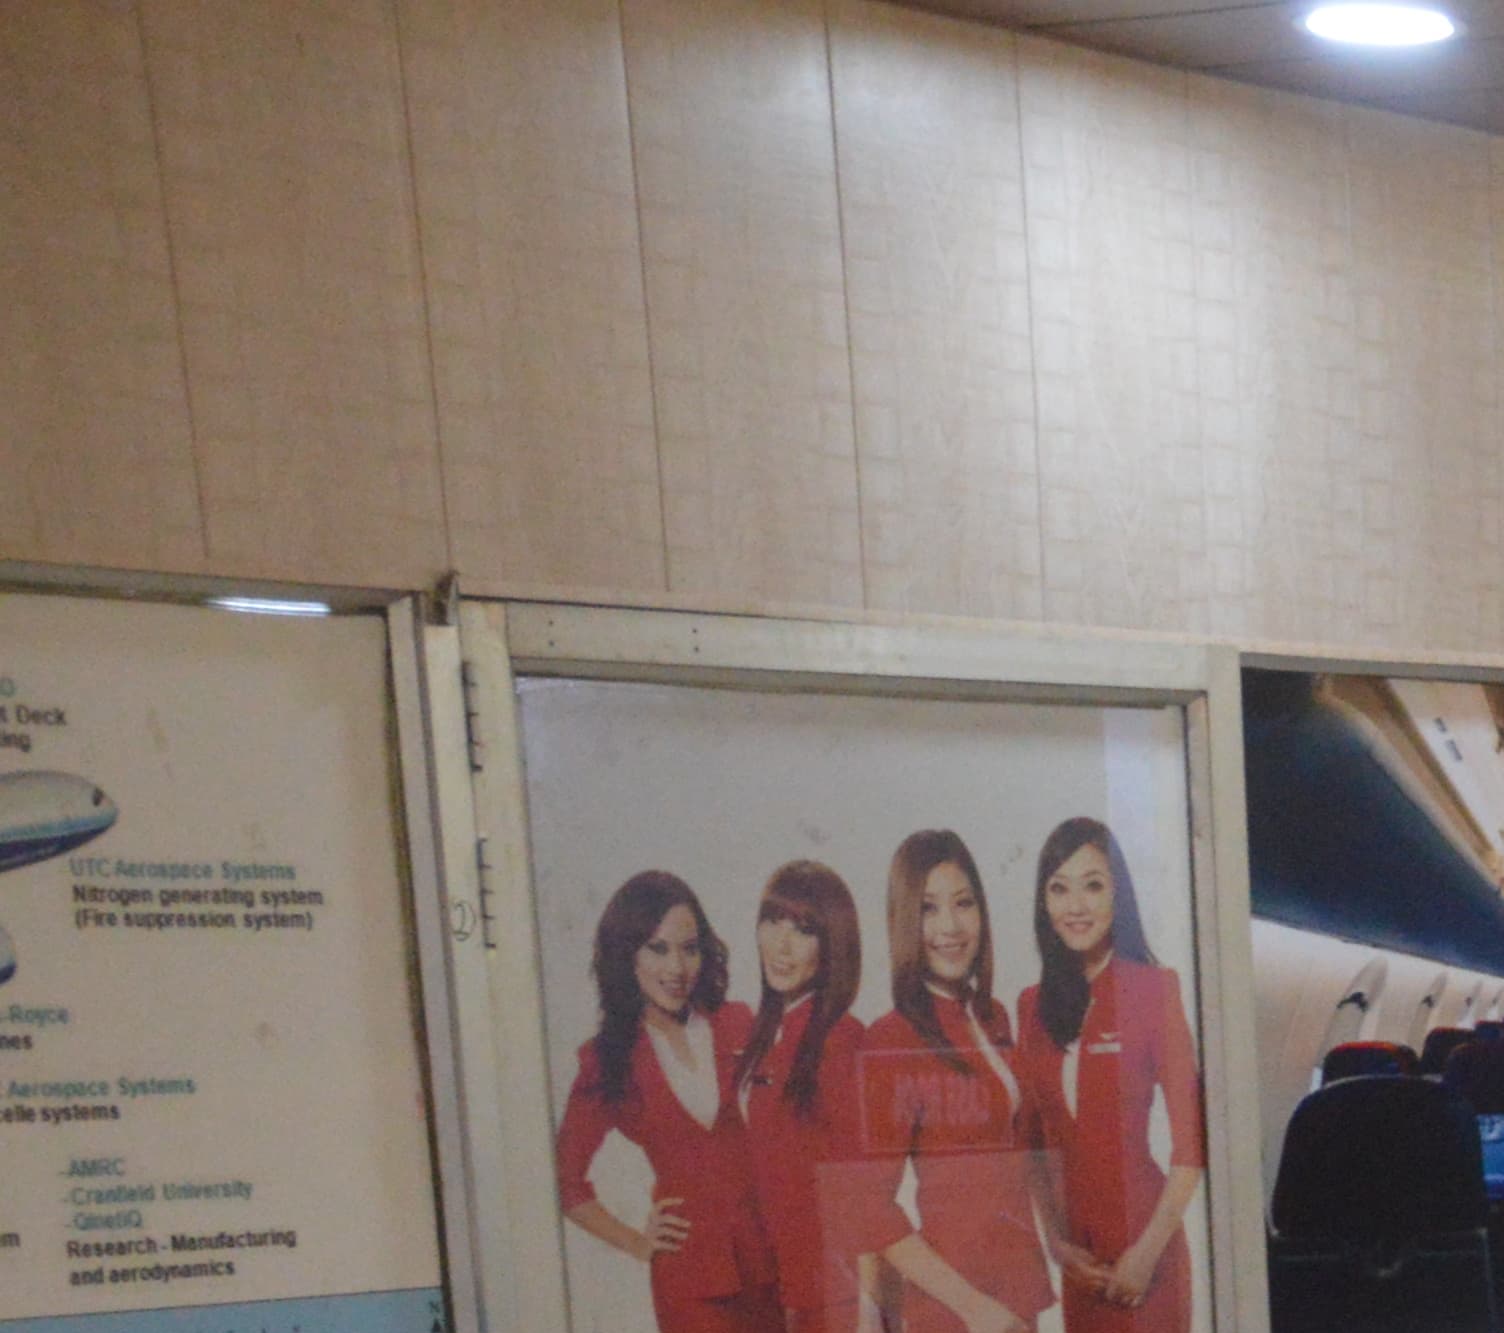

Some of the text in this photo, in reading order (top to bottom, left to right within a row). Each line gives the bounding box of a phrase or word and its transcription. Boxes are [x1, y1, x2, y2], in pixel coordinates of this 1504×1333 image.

[16, 703, 67, 726] Deck
[69, 857, 297, 883] UTC Aerospace Systems
[72, 884, 325, 909] Nitrogen generating system
[75, 909, 315, 932] (Fire suppression system)
[8, 1075, 198, 1101] Aerospace Systems
[40, 1103, 122, 1126] systems
[162, 1179, 255, 1203] University
[66, 1236, 159, 1259] Research
[170, 1227, 299, 1254] Manufacturing
[69, 1258, 237, 1287] and aerodynamics
